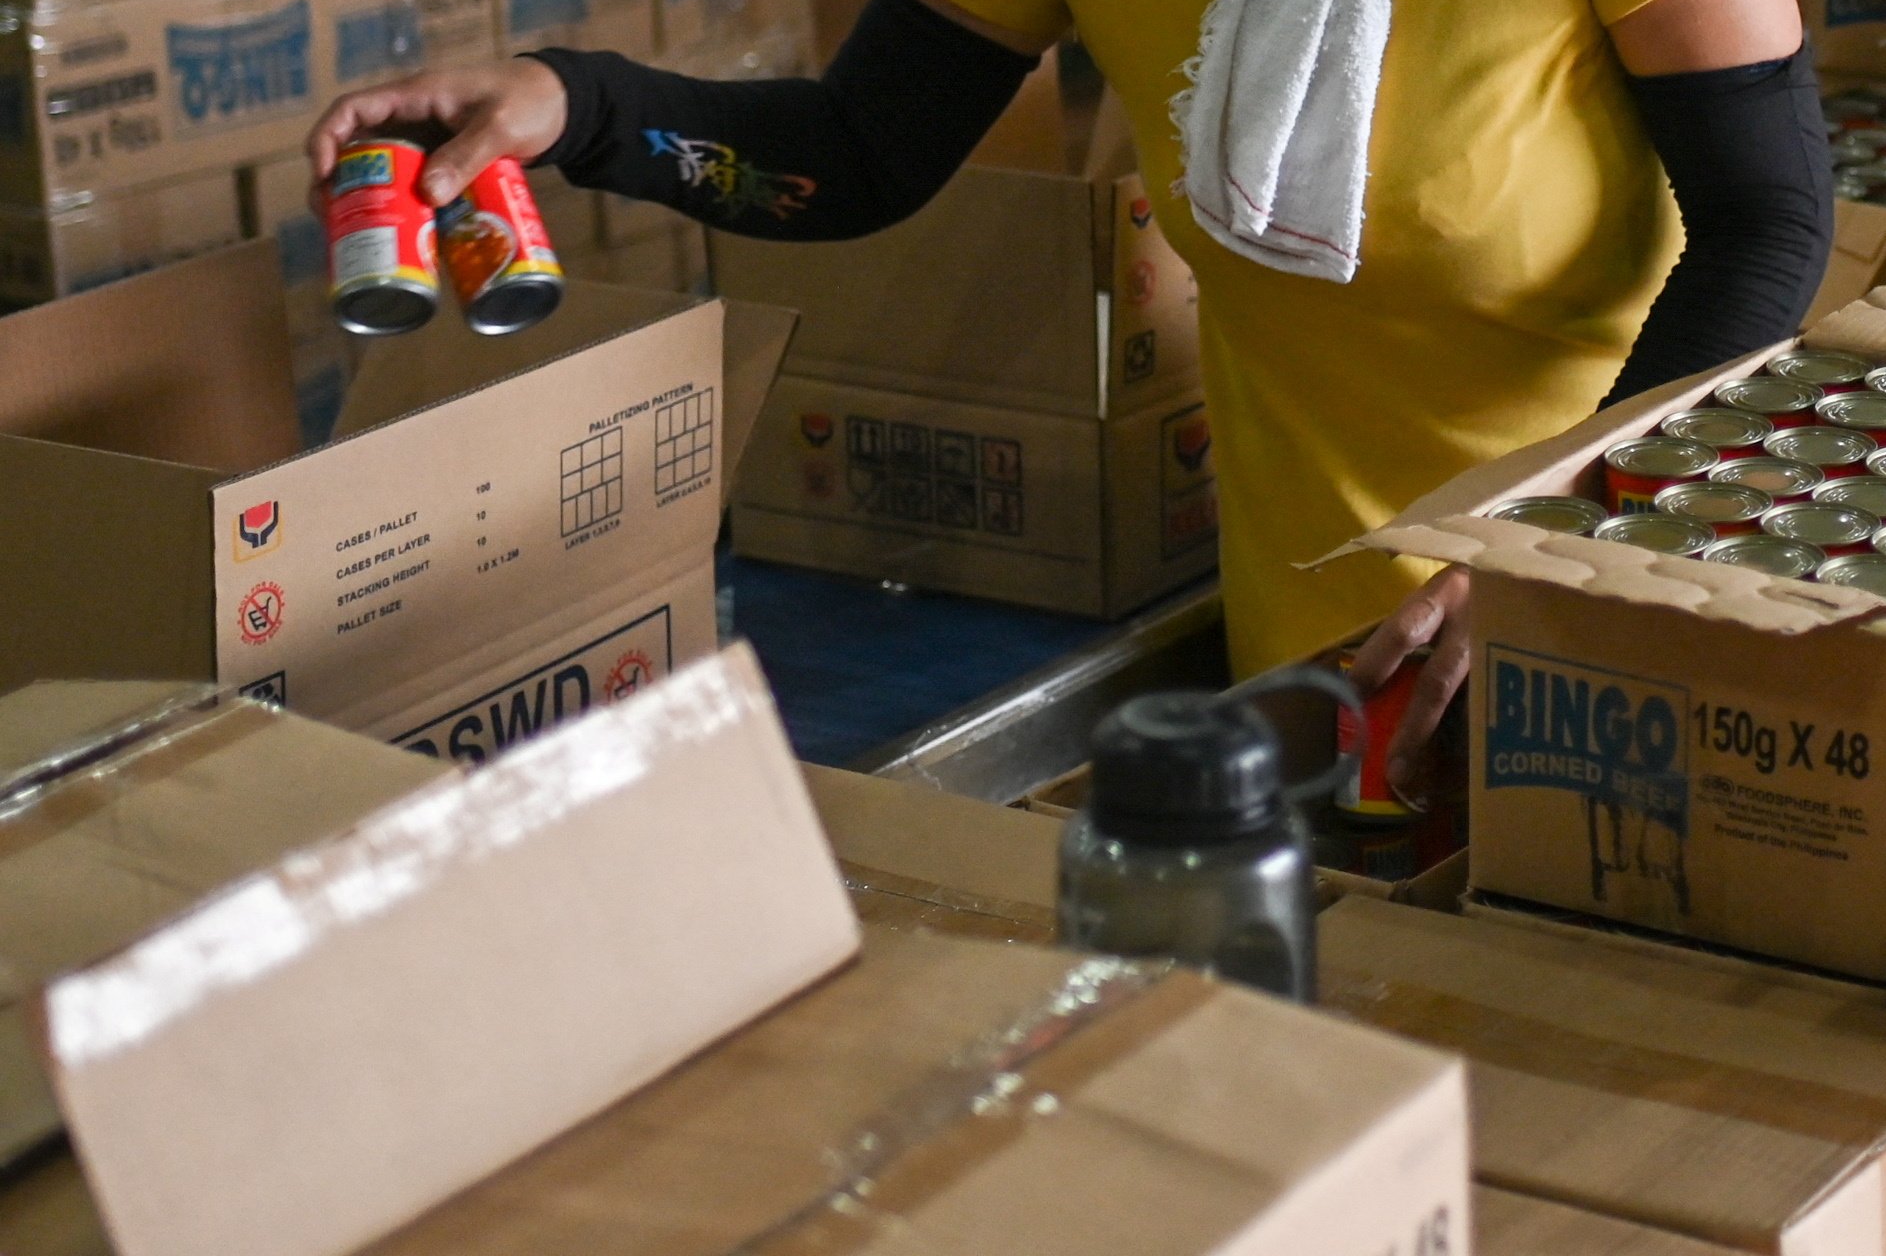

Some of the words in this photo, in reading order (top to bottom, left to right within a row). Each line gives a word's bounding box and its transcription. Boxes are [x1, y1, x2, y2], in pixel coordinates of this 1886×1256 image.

[589, 401, 650, 433] PALLETIZING
[652, 383, 693, 407] PATTERN
[476, 482, 491, 494] 100
[336, 530, 372, 552] CASES
[379, 512, 418, 535] PALLET
[476, 511, 486, 521] 10
[336, 558, 372, 580] CASES
[375, 549, 395, 564] PER
[398, 534, 431, 555] LAYER
[477, 537, 487, 547] 10
[337, 577, 390, 607] STACKING
[392, 560, 431, 584] HEIGHT
[337, 610, 377, 635] PALLET
[379, 600, 403, 618] SIZE
[404, 663, 590, 767] SWD
[1495, 660, 1678, 774] BINGO
[1693, 702, 1777, 774] 150g
[1788, 721, 1814, 772] X
[1824, 731, 1870, 780] 48
[1493, 751, 1602, 784] CORNED
[1613, 773, 1684, 816] BEEF
